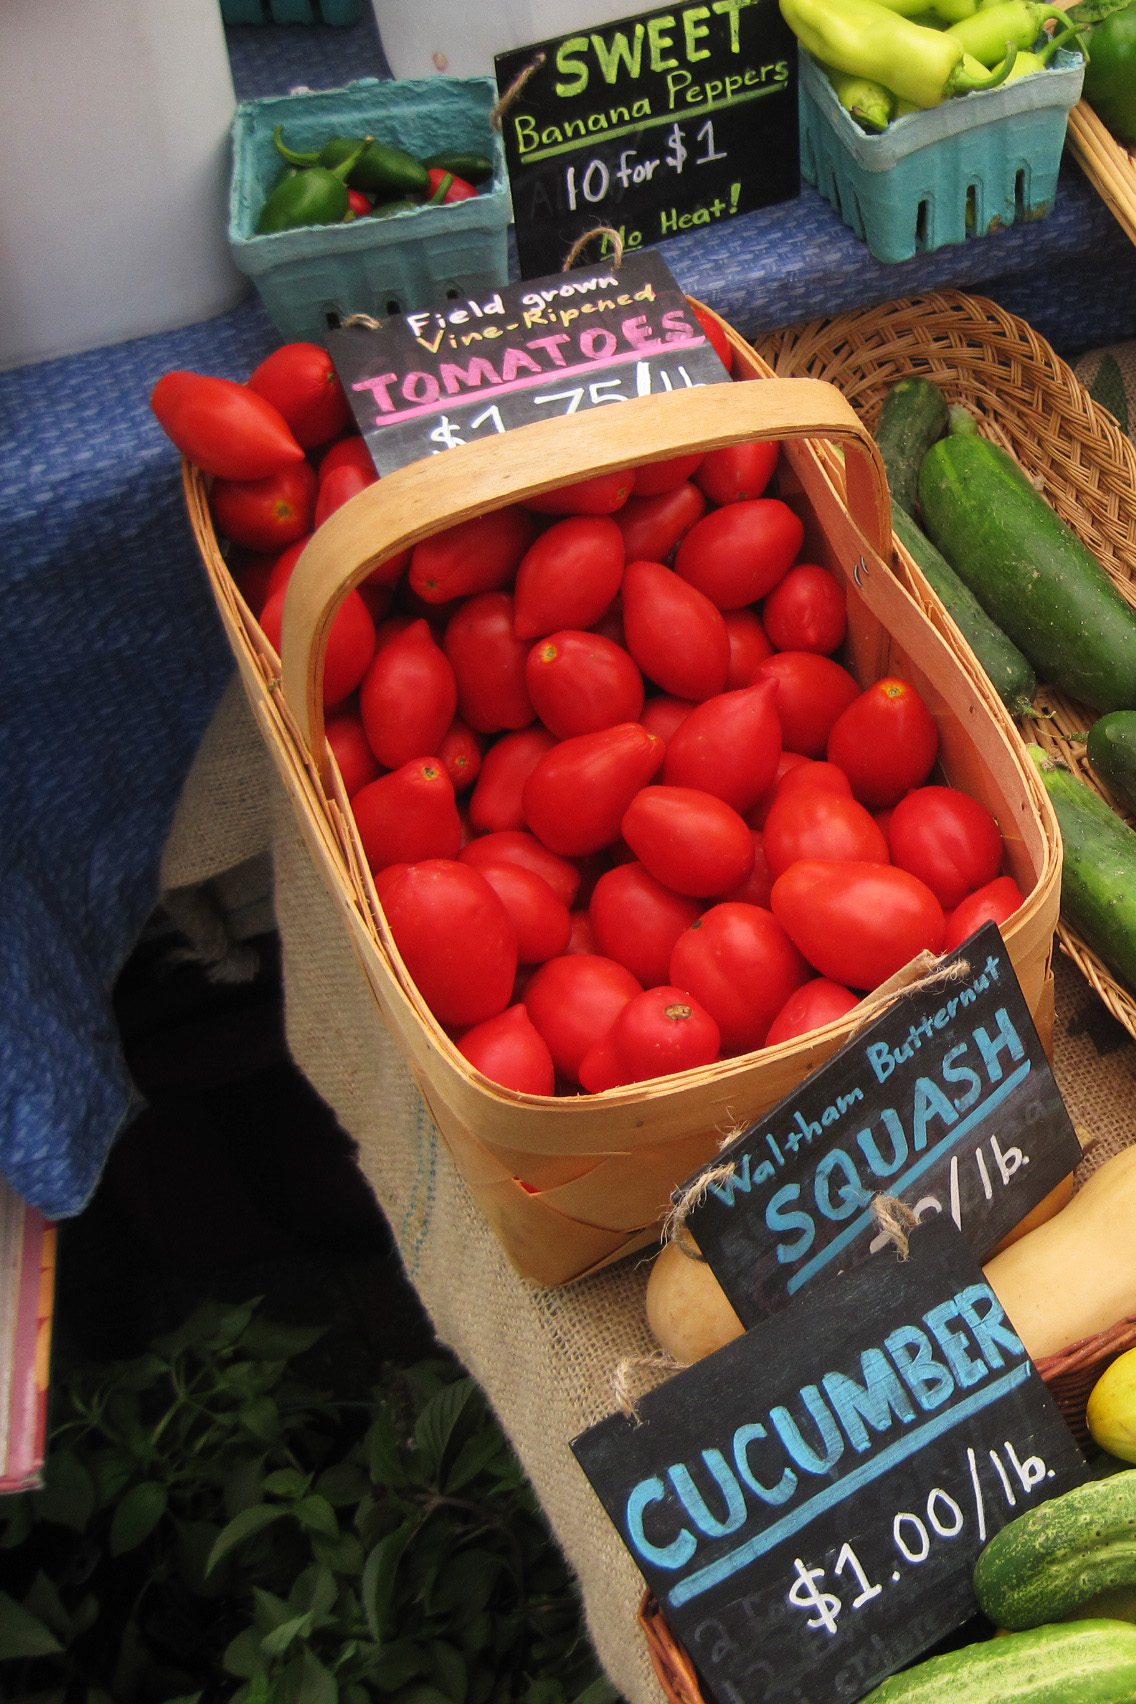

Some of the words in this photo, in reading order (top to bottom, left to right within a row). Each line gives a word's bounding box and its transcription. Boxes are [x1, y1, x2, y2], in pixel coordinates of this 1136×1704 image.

[555, 0, 756, 98] SWEET
[514, 97, 652, 154] Banana
[666, 59, 789, 110] Peppers
[566, 160, 609, 211] 10
[617, 151, 660, 188] for
[600, 226, 642, 256] No
[660, 183, 742, 235] Heat!
[407, 294, 505, 337] Field
[522, 275, 619, 310] grown
[416, 284, 657, 354] Vine-Ripened
[352, 310, 696, 413] TOMATOES
[708, 1086, 865, 1207] Waltham
[866, 955, 1001, 1084] Butternut
[765, 1007, 1025, 1264] SQUASH
[626, 1283, 1024, 1569] CUCUMBER
[788, 1442, 1055, 1634] $1.00/lb.
